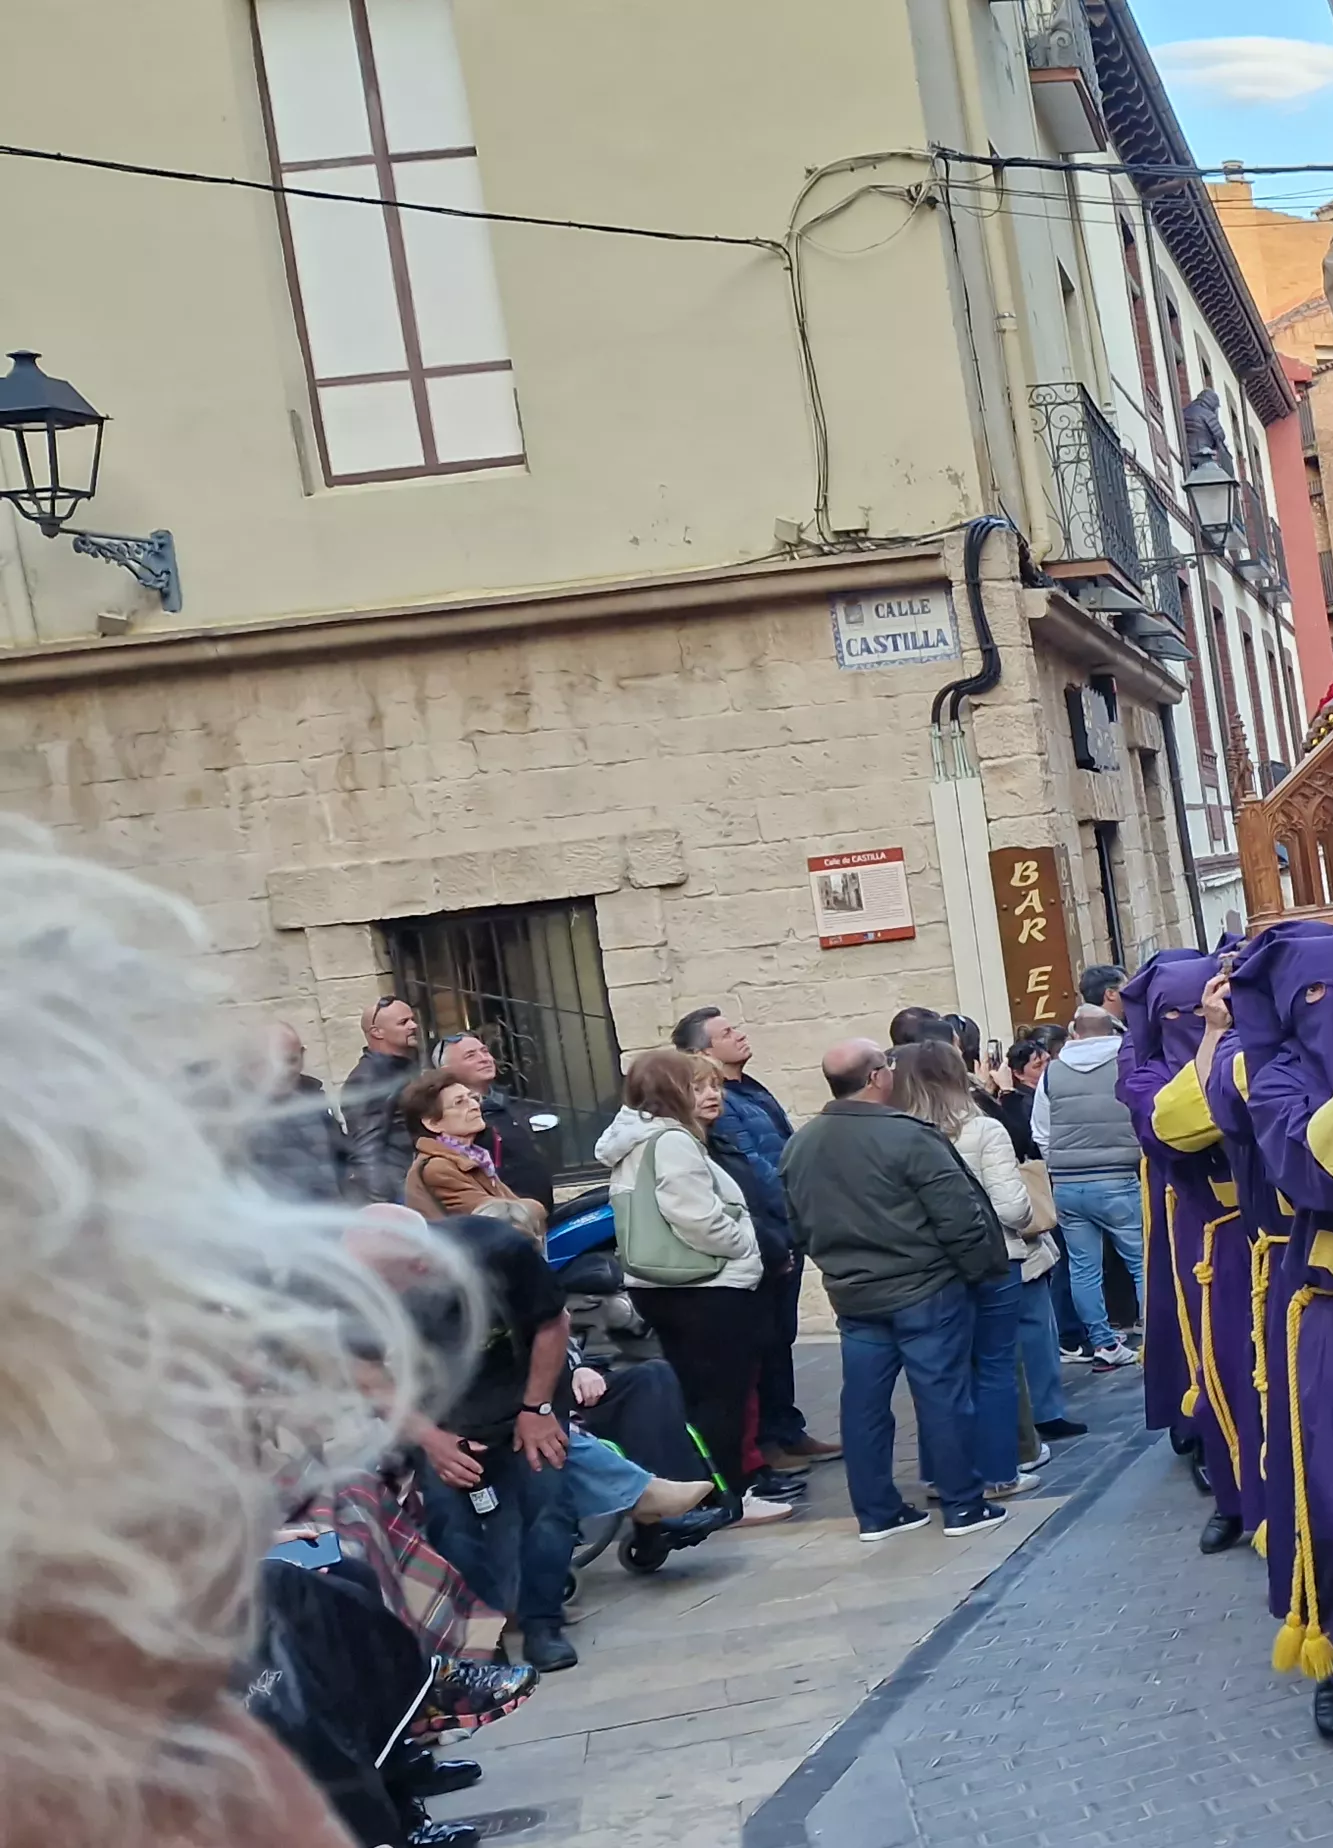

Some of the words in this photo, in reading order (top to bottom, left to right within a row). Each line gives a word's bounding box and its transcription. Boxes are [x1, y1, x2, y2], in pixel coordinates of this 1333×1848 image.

[875, 598, 931, 619] CALLE
[846, 628, 949, 657] CASTILLA
[824, 858, 840, 866] Calle
[851, 852, 886, 862] CASTILLA
[1009, 860, 1047, 944] BAR
[1060, 857, 1076, 936] BAR
[1026, 965, 1056, 1020] EL
